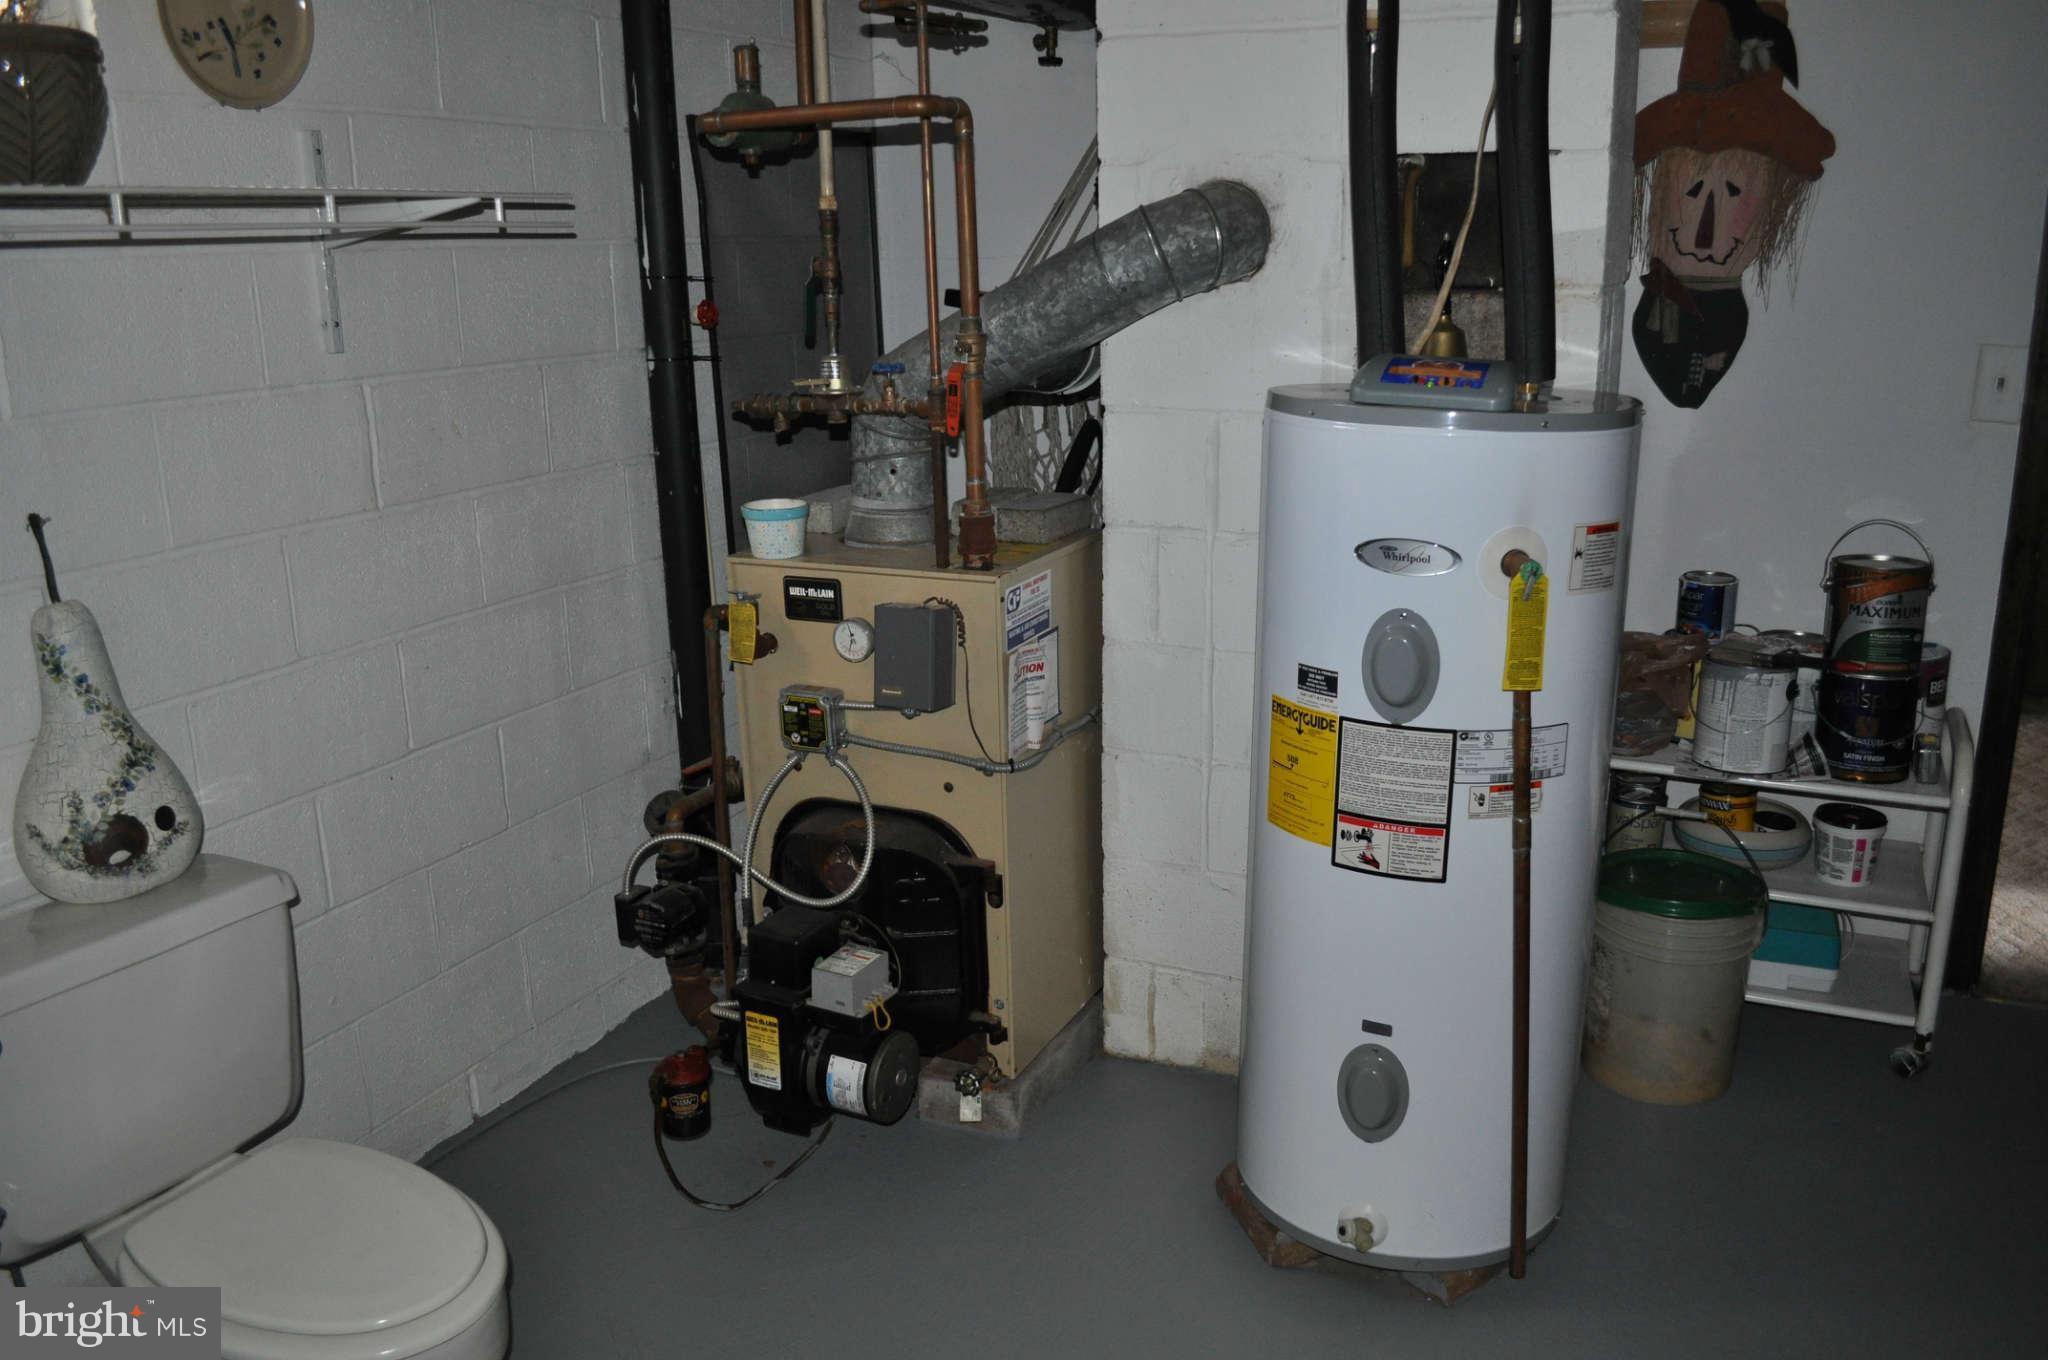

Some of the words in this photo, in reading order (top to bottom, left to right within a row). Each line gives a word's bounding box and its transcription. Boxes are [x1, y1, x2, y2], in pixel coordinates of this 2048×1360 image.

[1383, 550, 1432, 565] Whirlpool
[1848, 603, 1922, 619] MAXIMUM
[1272, 699, 1336, 734] ENERGYGUIDE
[1379, 824, 1416, 834] DANGER
